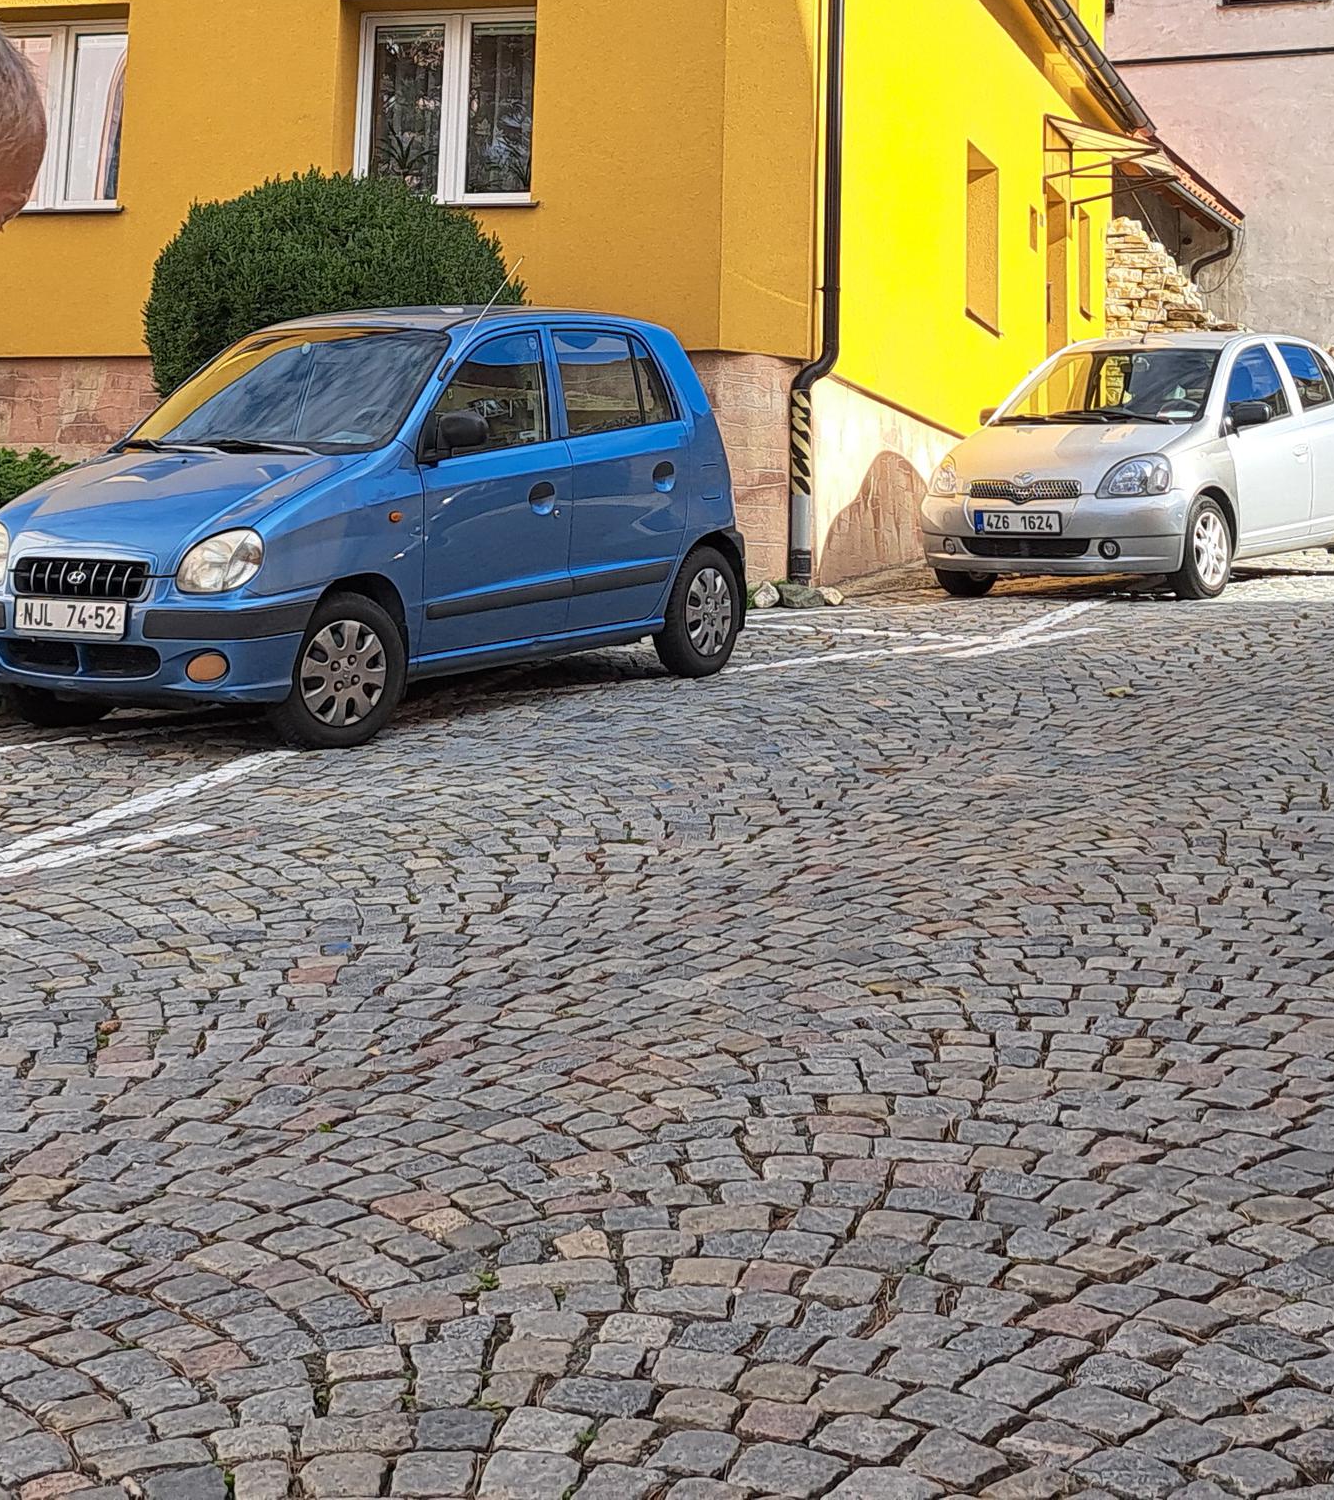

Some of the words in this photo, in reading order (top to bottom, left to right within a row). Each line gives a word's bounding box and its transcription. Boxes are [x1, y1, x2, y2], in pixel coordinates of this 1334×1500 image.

[986, 514, 1010, 530] 4Z6
[1020, 515, 1053, 531] 1624
[23, 602, 53, 627] NJL
[66, 604, 116, 630] 74-52
